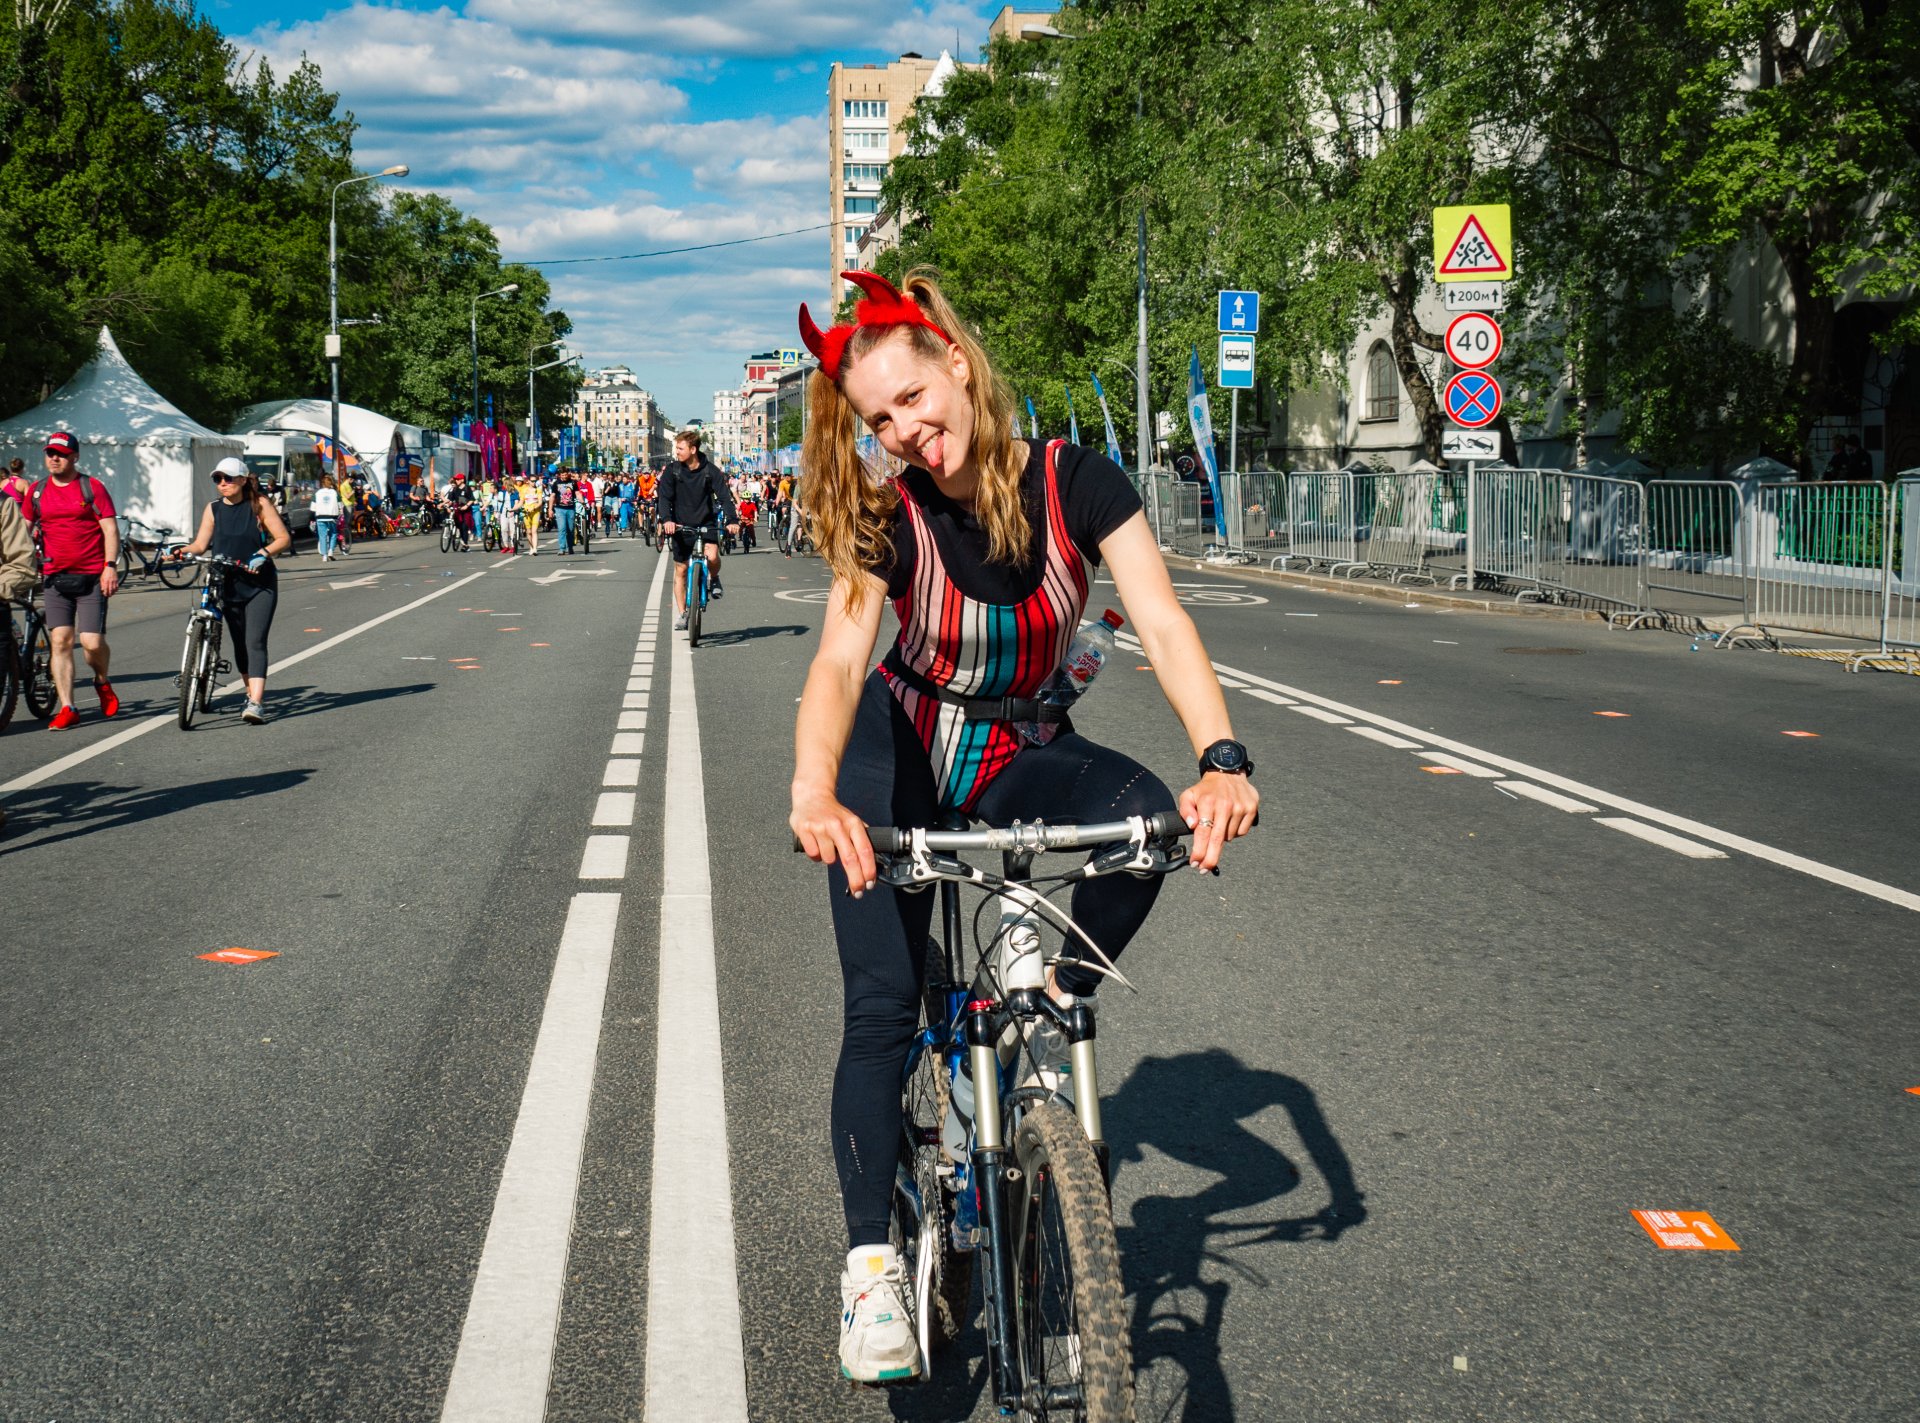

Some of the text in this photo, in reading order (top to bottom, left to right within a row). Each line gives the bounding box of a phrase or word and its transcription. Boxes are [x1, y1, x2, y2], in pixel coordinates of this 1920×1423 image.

[1456, 330, 1489, 352] 40
[1076, 656, 1098, 676] spring
[1082, 651, 1101, 667] saint
